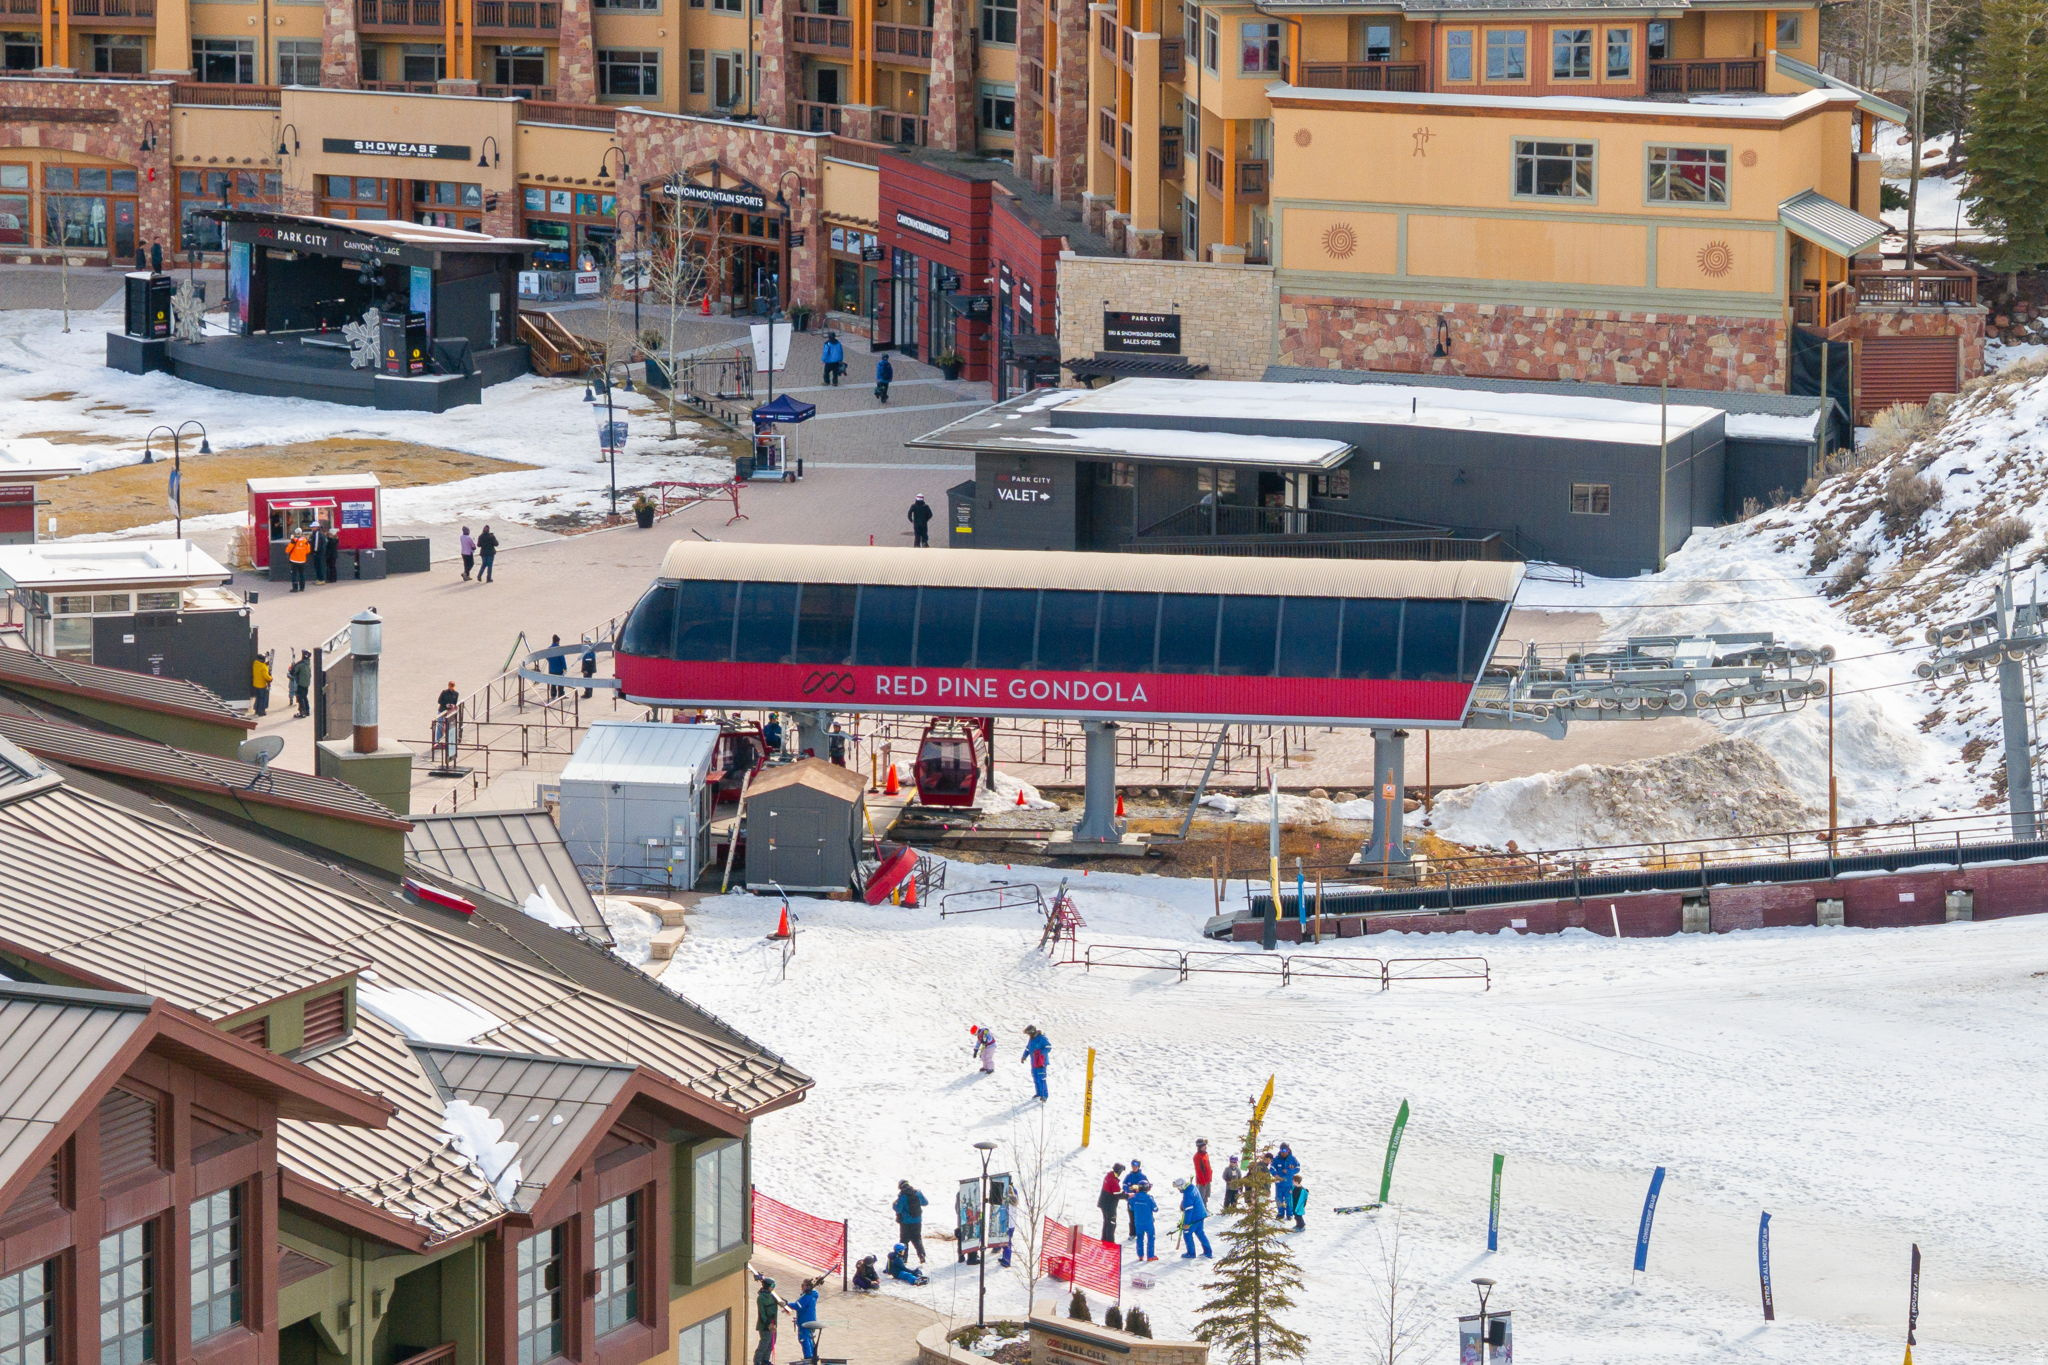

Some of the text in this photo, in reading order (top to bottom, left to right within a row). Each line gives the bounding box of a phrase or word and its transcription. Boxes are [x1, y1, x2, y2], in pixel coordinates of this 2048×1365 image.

[354, 141, 438, 154] SHOWCASE
[664, 185, 764, 207] CANYON MOUNTAIN SPORTS
[277, 230, 328, 247] PARK CITY
[1121, 330, 1154, 338] SNOWBOARD
[1011, 475, 1031, 483] PARK
[997, 488, 1038, 502] VALET
[876, 674, 1148, 702] RED PINE GONDOLA
[1392, 1126, 1403, 1149] TURNS
[1648, 1193, 1657, 1209] BLUE
[1763, 1275, 1769, 1285] TO
[1911, 1273, 1919, 1313] MOUNTAIN
